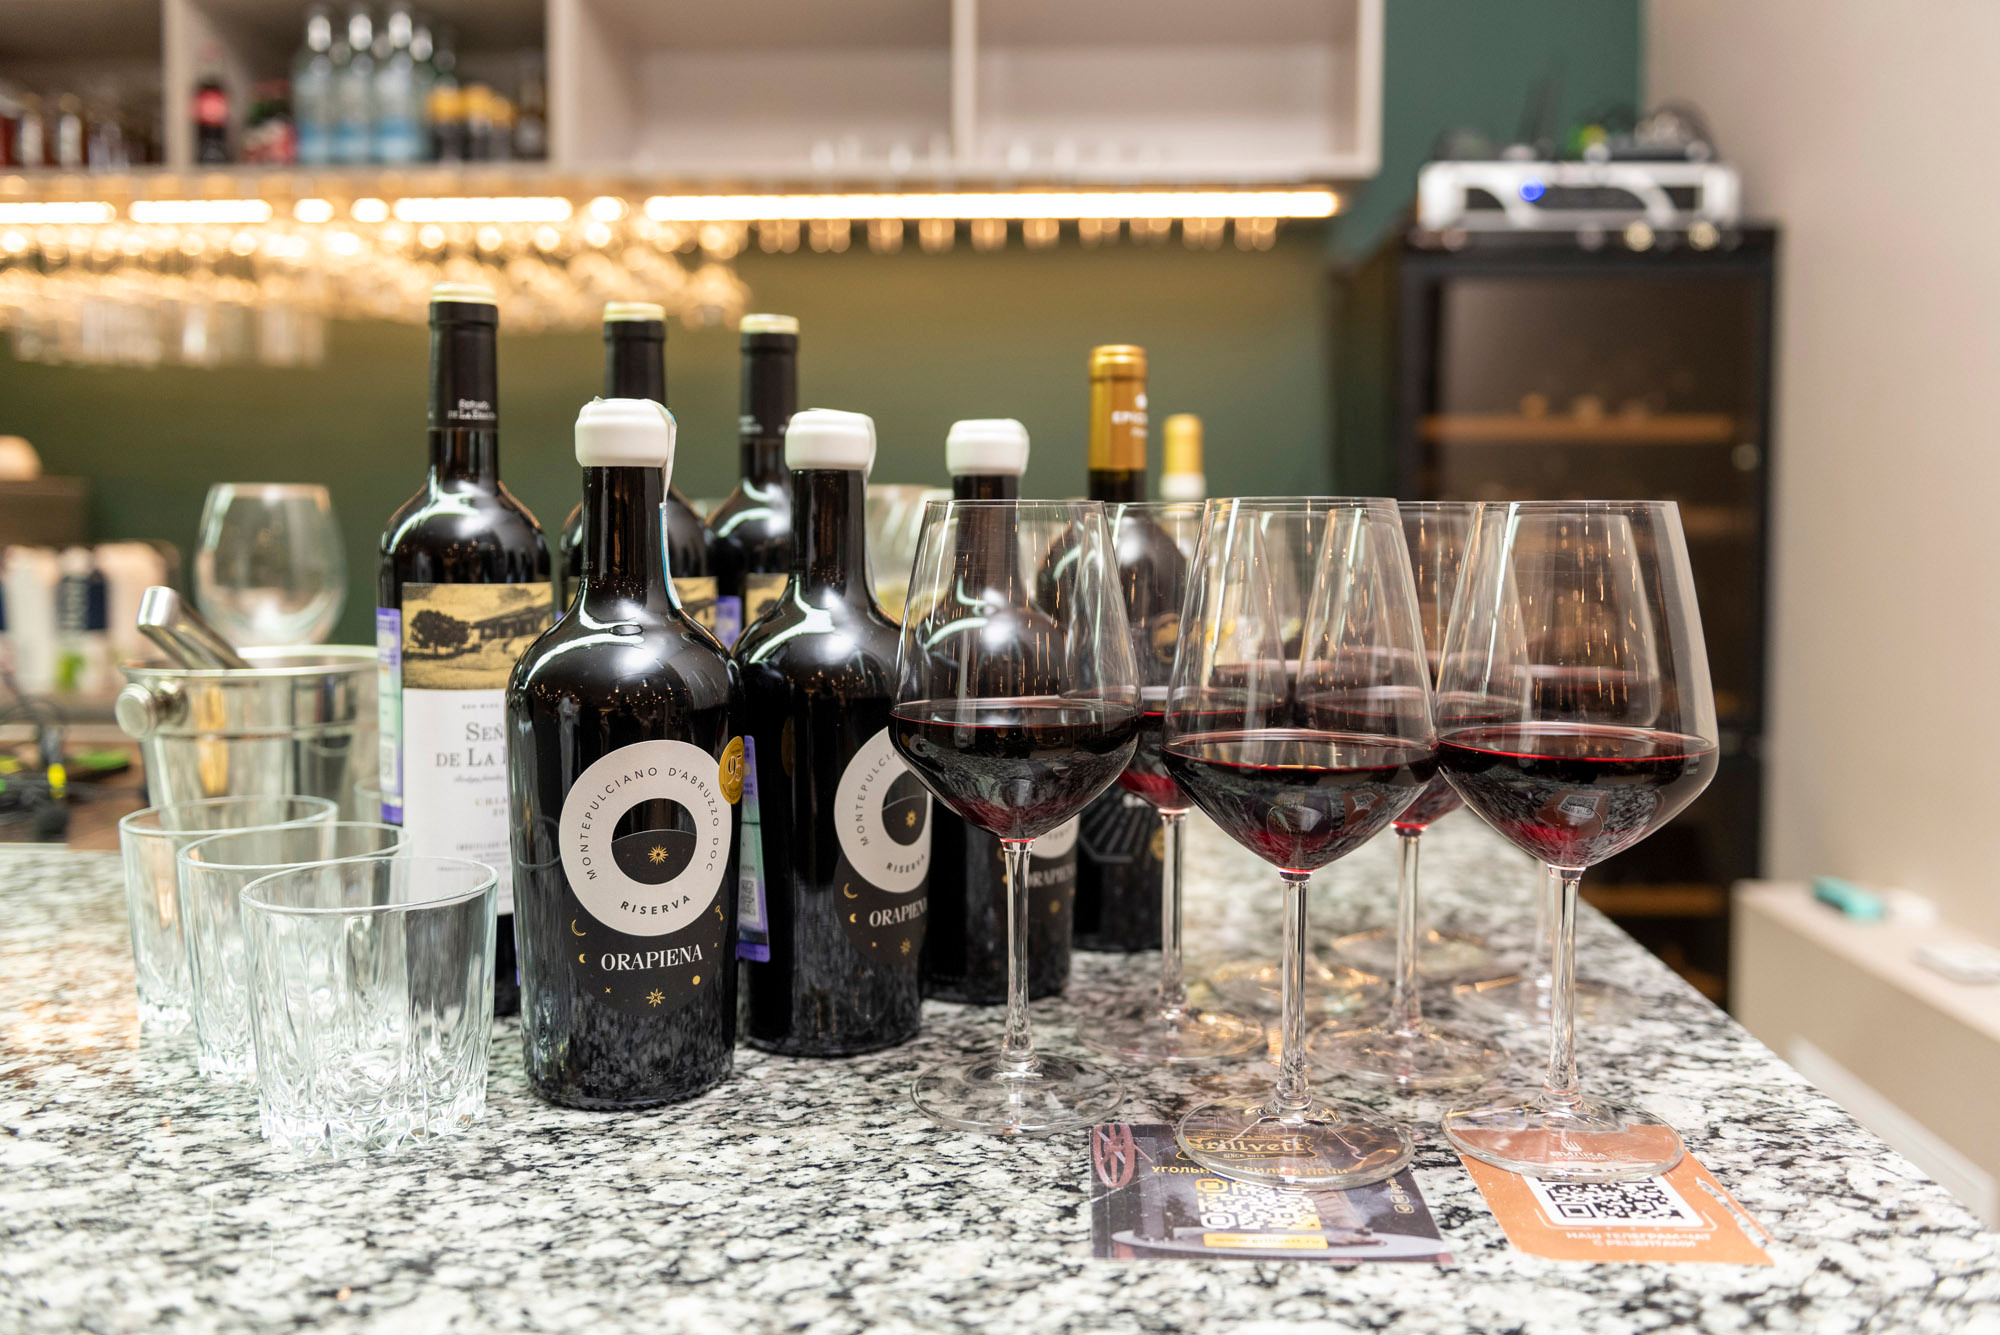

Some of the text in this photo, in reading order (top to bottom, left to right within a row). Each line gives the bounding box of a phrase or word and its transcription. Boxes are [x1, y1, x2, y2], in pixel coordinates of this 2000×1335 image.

[436, 752, 460, 767] DE
[467, 747, 496, 767] LA
[728, 752, 743, 785] 95
[579, 766, 720, 881] MONTEPULCIANO D'ABRUZZO DOC
[886, 853, 925, 874] RISERVA
[620, 894, 691, 915] RISERVA
[600, 944, 704, 972] ORAPIENA
[1151, 1165, 1213, 1174] УГОЛЬН
